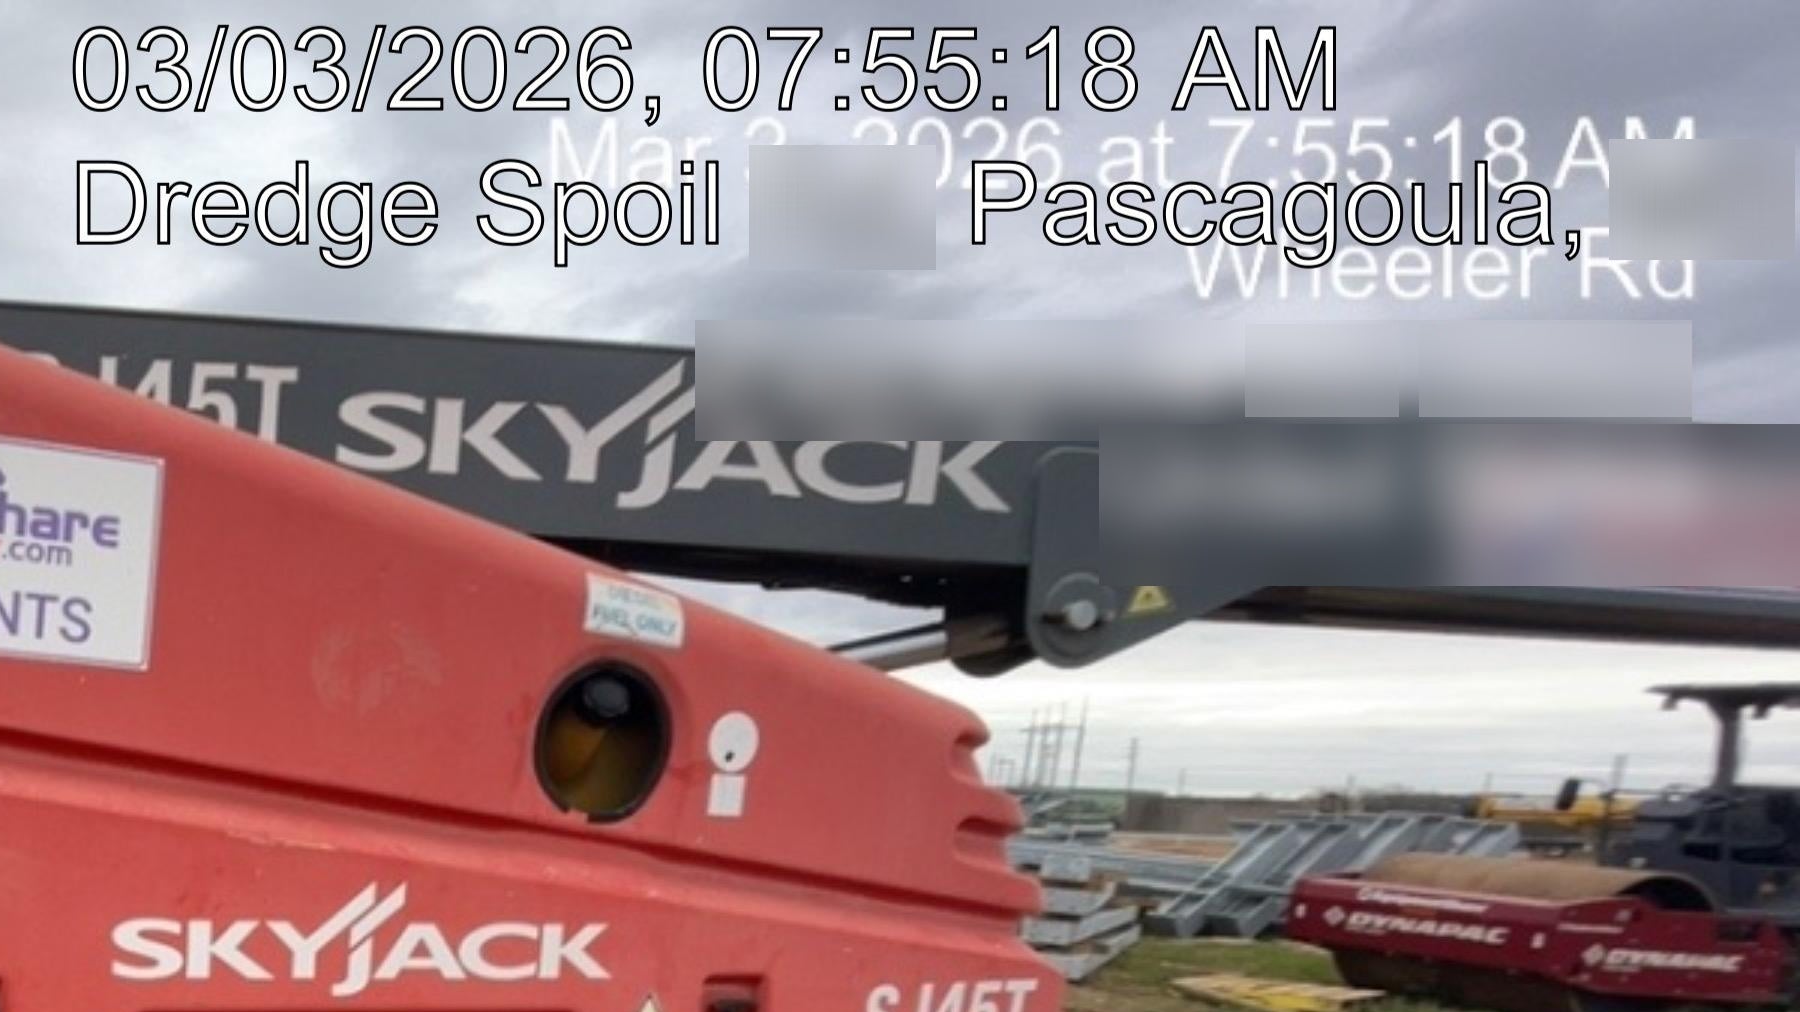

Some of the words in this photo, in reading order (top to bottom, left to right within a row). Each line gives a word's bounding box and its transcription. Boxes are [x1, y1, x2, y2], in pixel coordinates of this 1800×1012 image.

[335, 357, 1013, 514] SKYJACK
[1, 539, 73, 567] .com
[110, 881, 612, 998] SKYJACK
[1348, 911, 1511, 945] DYNAPAC
